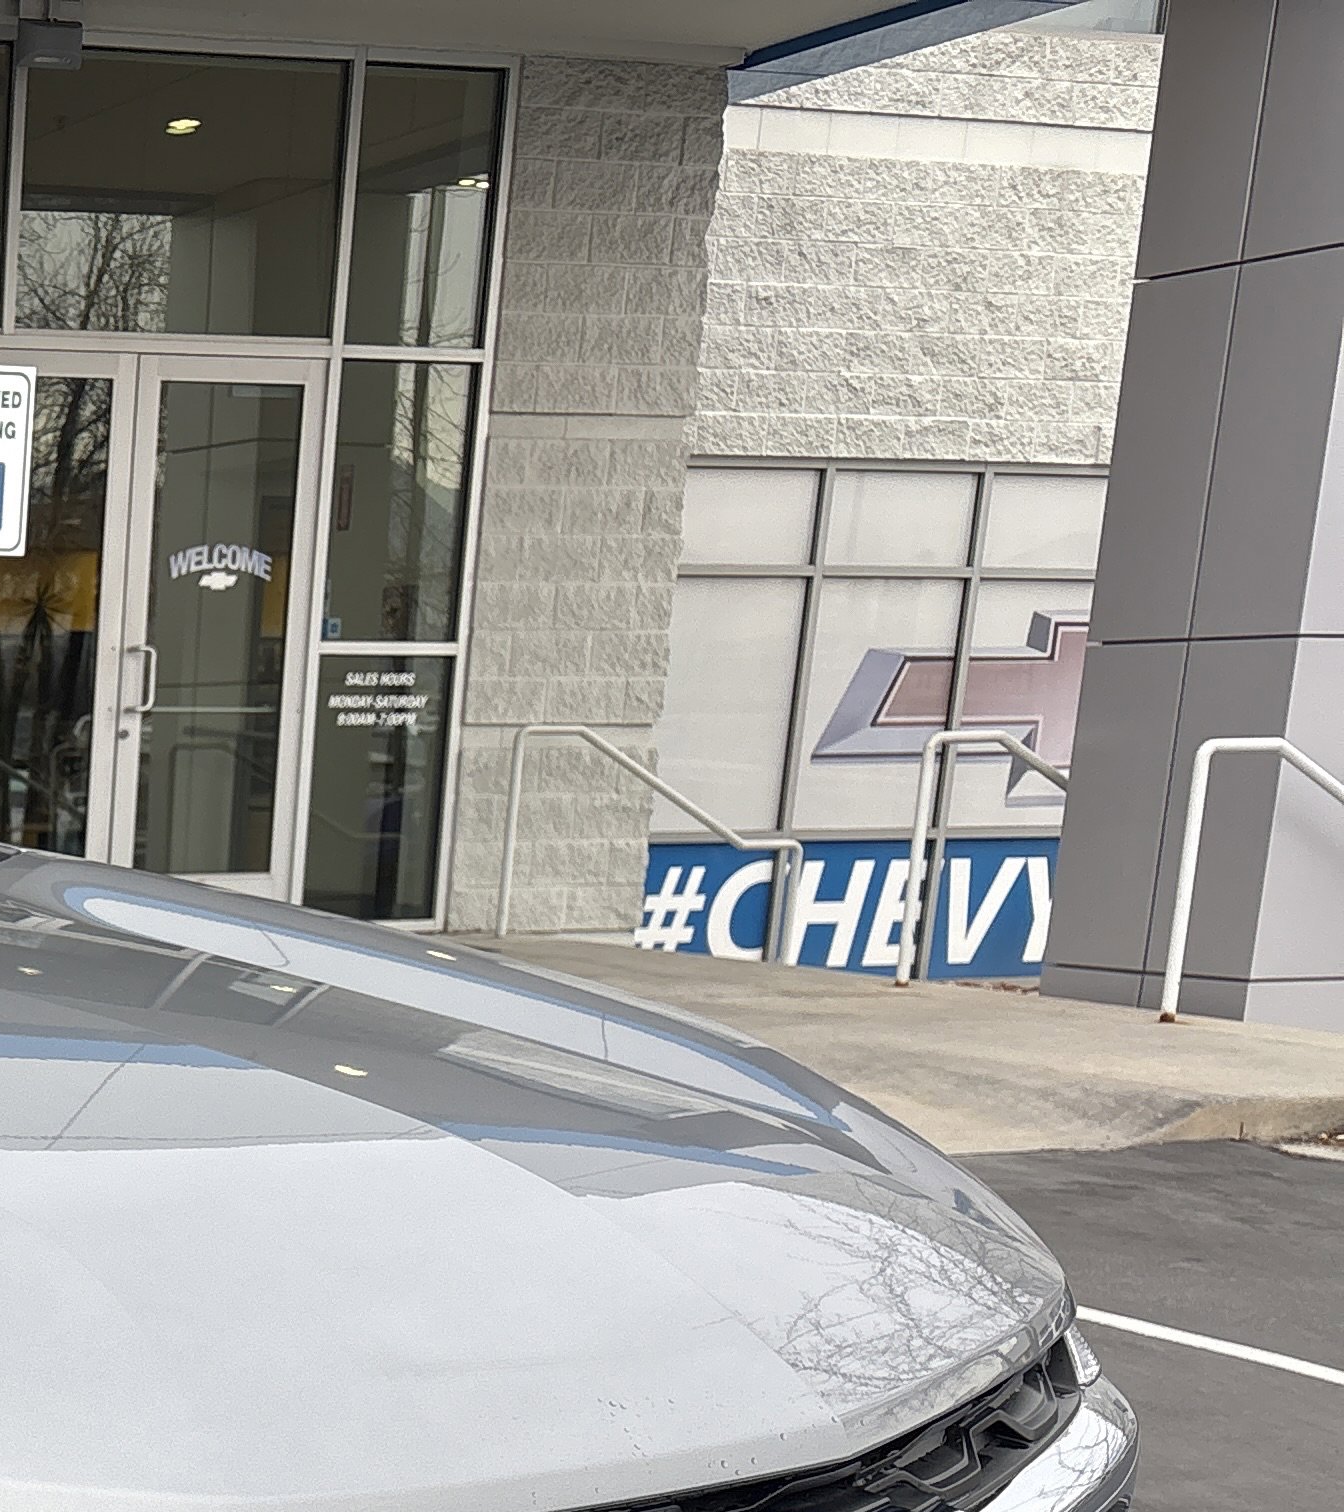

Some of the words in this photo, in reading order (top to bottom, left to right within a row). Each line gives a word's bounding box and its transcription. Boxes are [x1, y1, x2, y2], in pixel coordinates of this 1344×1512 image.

[169, 543, 273, 582] WELCOME
[345, 671, 379, 687] SALES
[379, 671, 417, 687] HOURS
